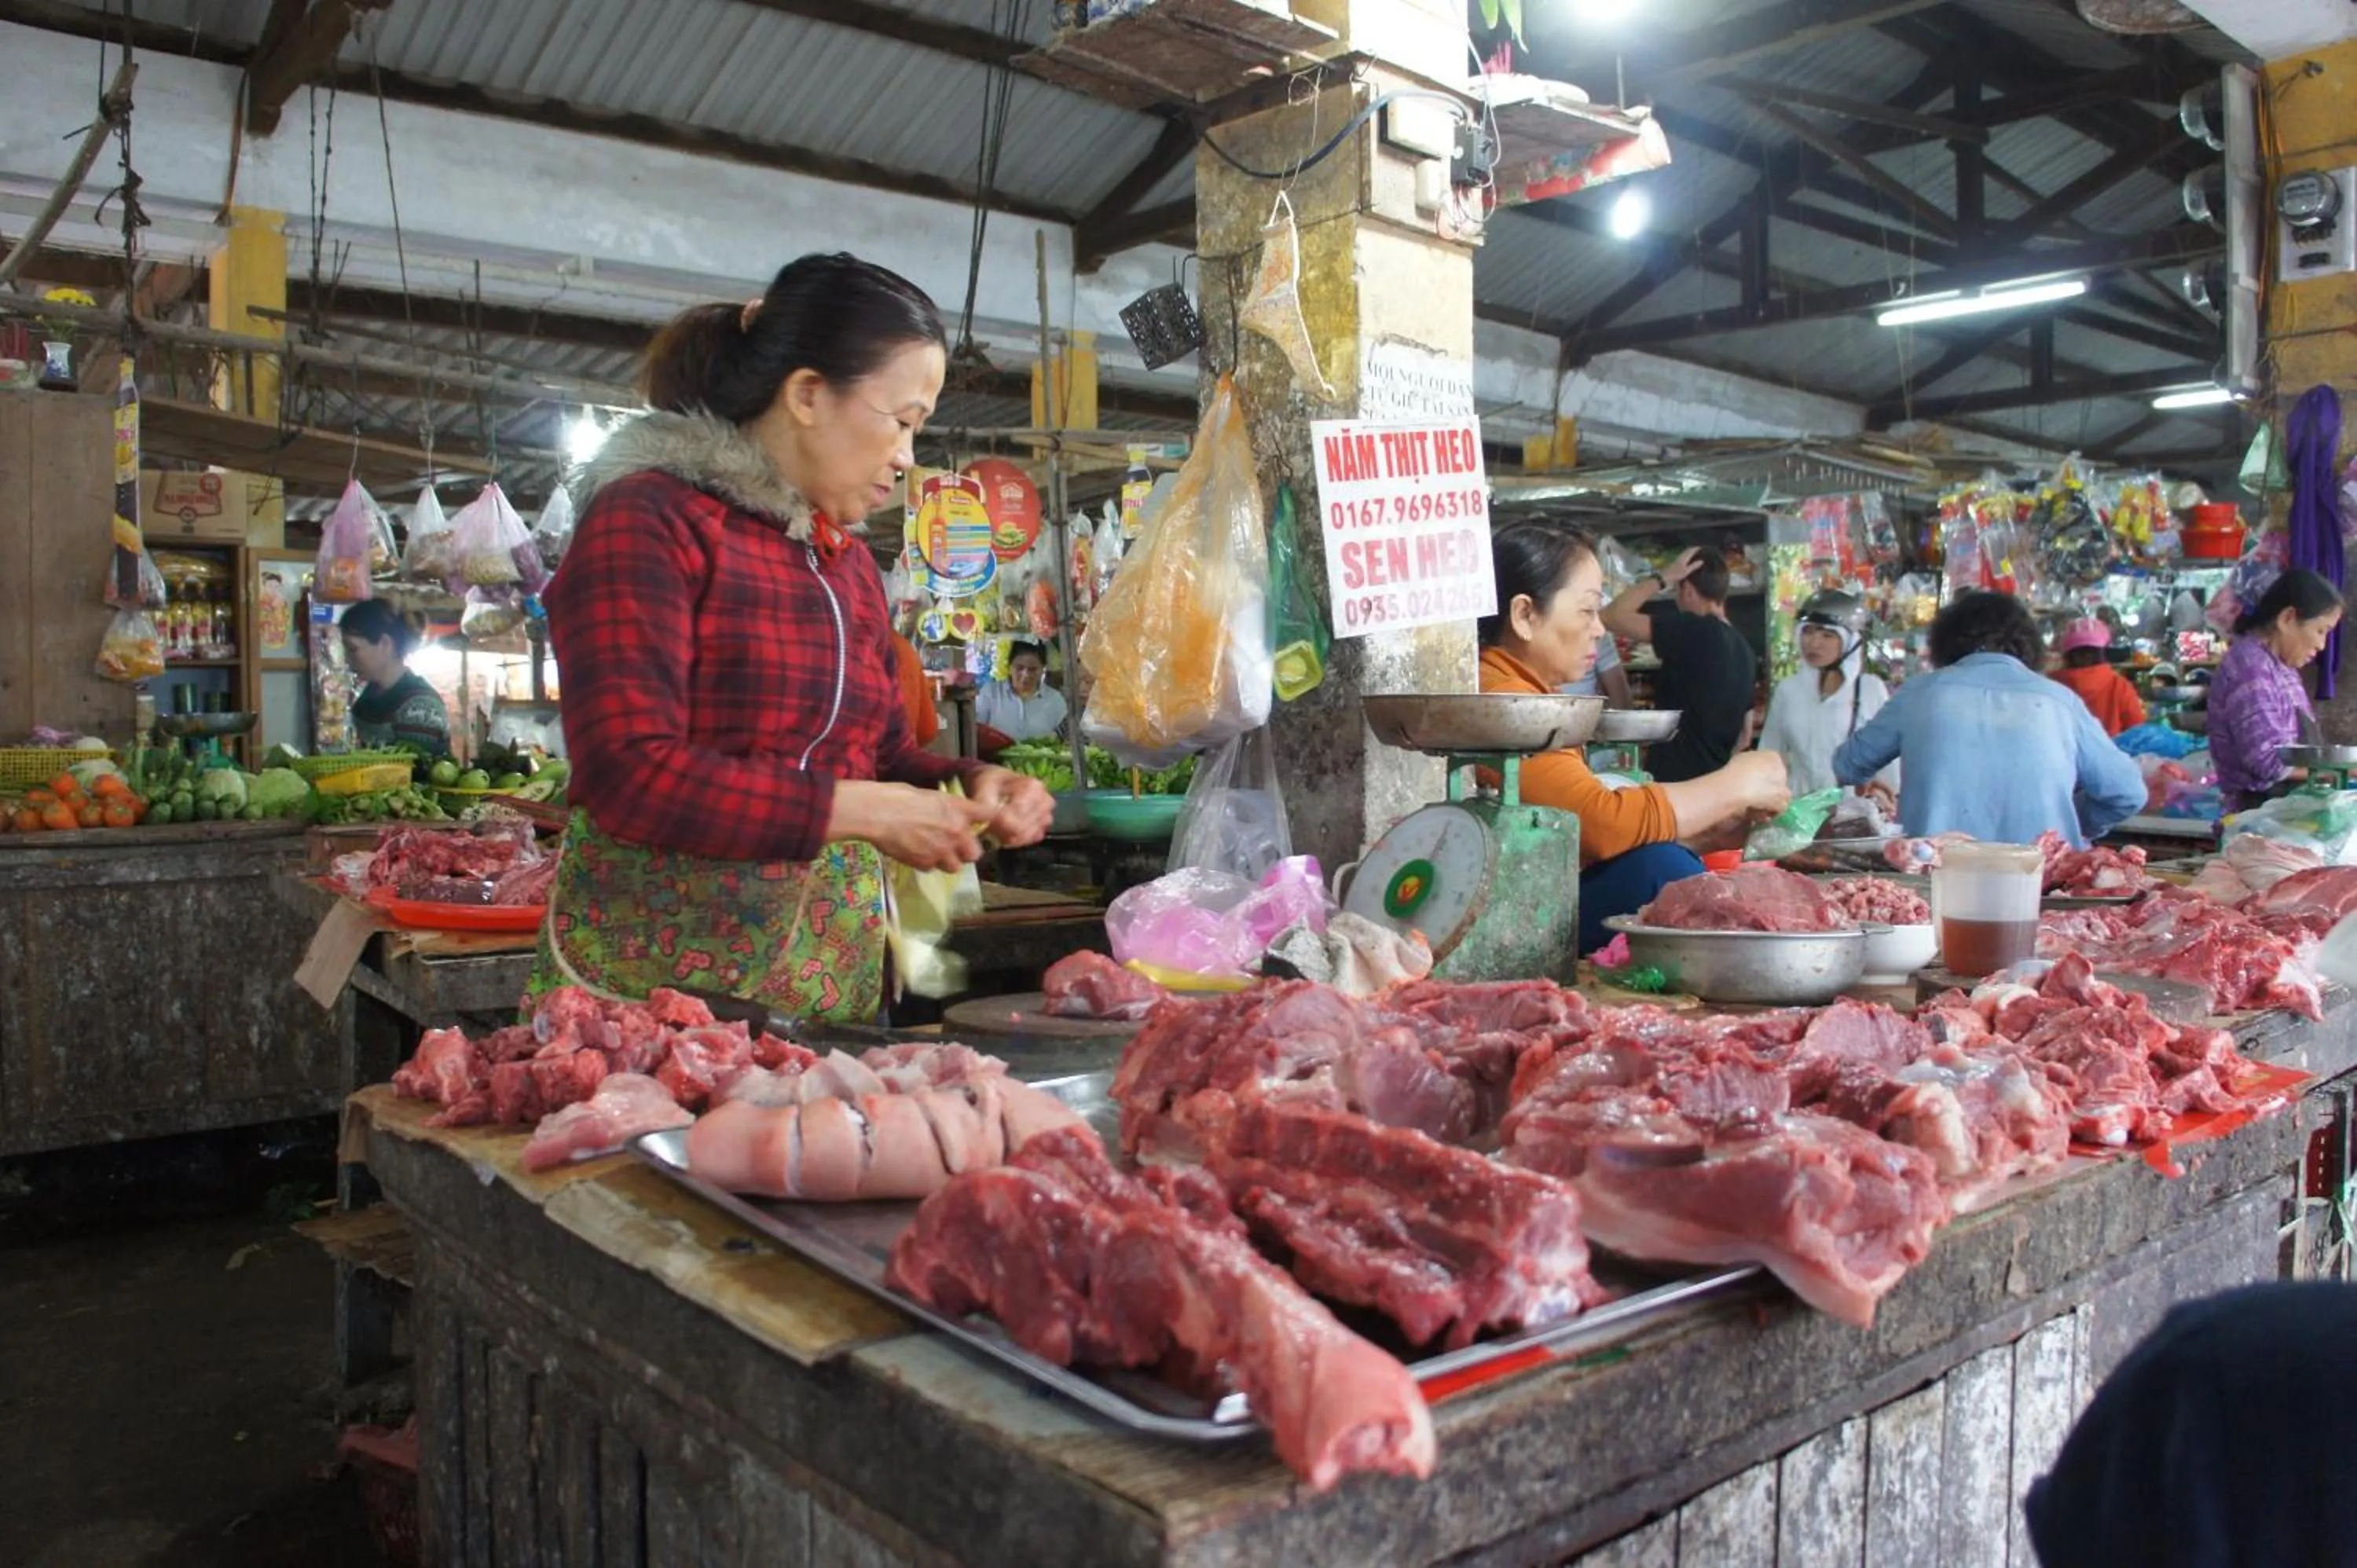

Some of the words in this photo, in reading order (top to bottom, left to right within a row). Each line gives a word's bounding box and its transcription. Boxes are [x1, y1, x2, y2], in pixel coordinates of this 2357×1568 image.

[1324, 428, 1379, 482] NĂM
[1380, 430, 1430, 485] THỊT
[1433, 428, 1476, 474] HEO
[1330, 489, 1483, 530] 0167.9696318
[1340, 537, 1410, 589] SEN
[1415, 528, 1479, 580] HEO
